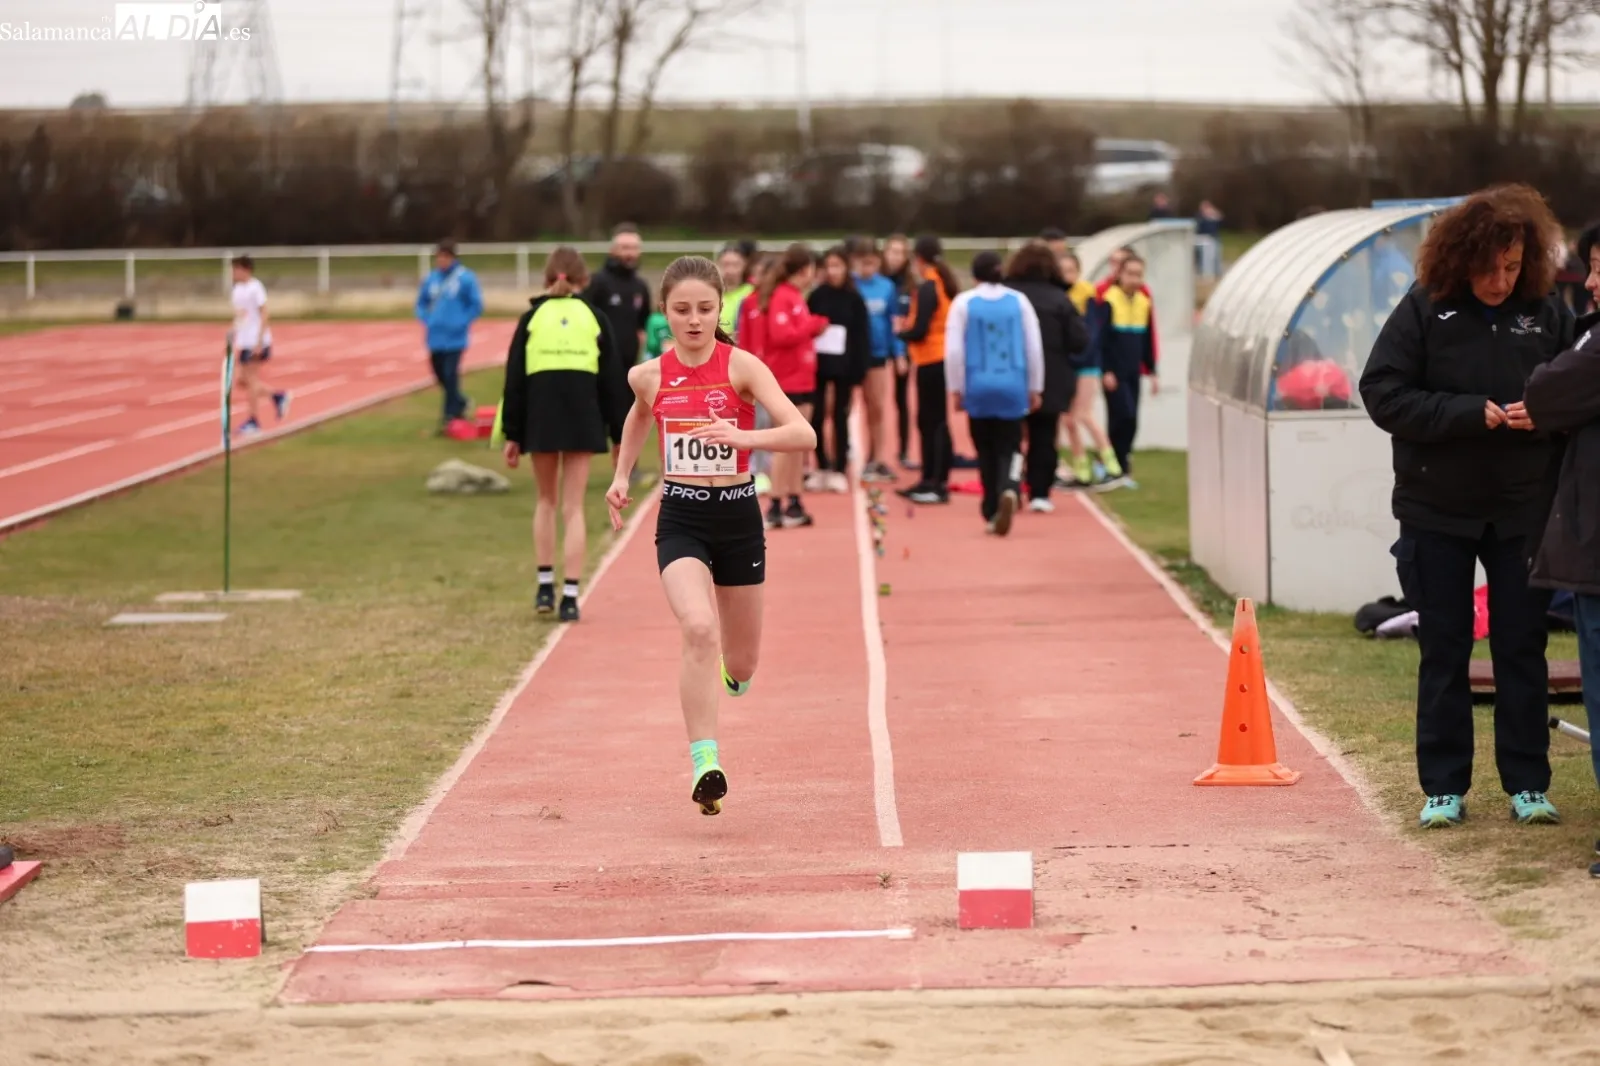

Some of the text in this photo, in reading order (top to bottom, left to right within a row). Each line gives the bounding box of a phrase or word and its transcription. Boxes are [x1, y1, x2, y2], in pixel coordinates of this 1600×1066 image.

[673, 437, 733, 461] 1069
[670, 485, 711, 501] PRO
[719, 484, 756, 501] NIKE
